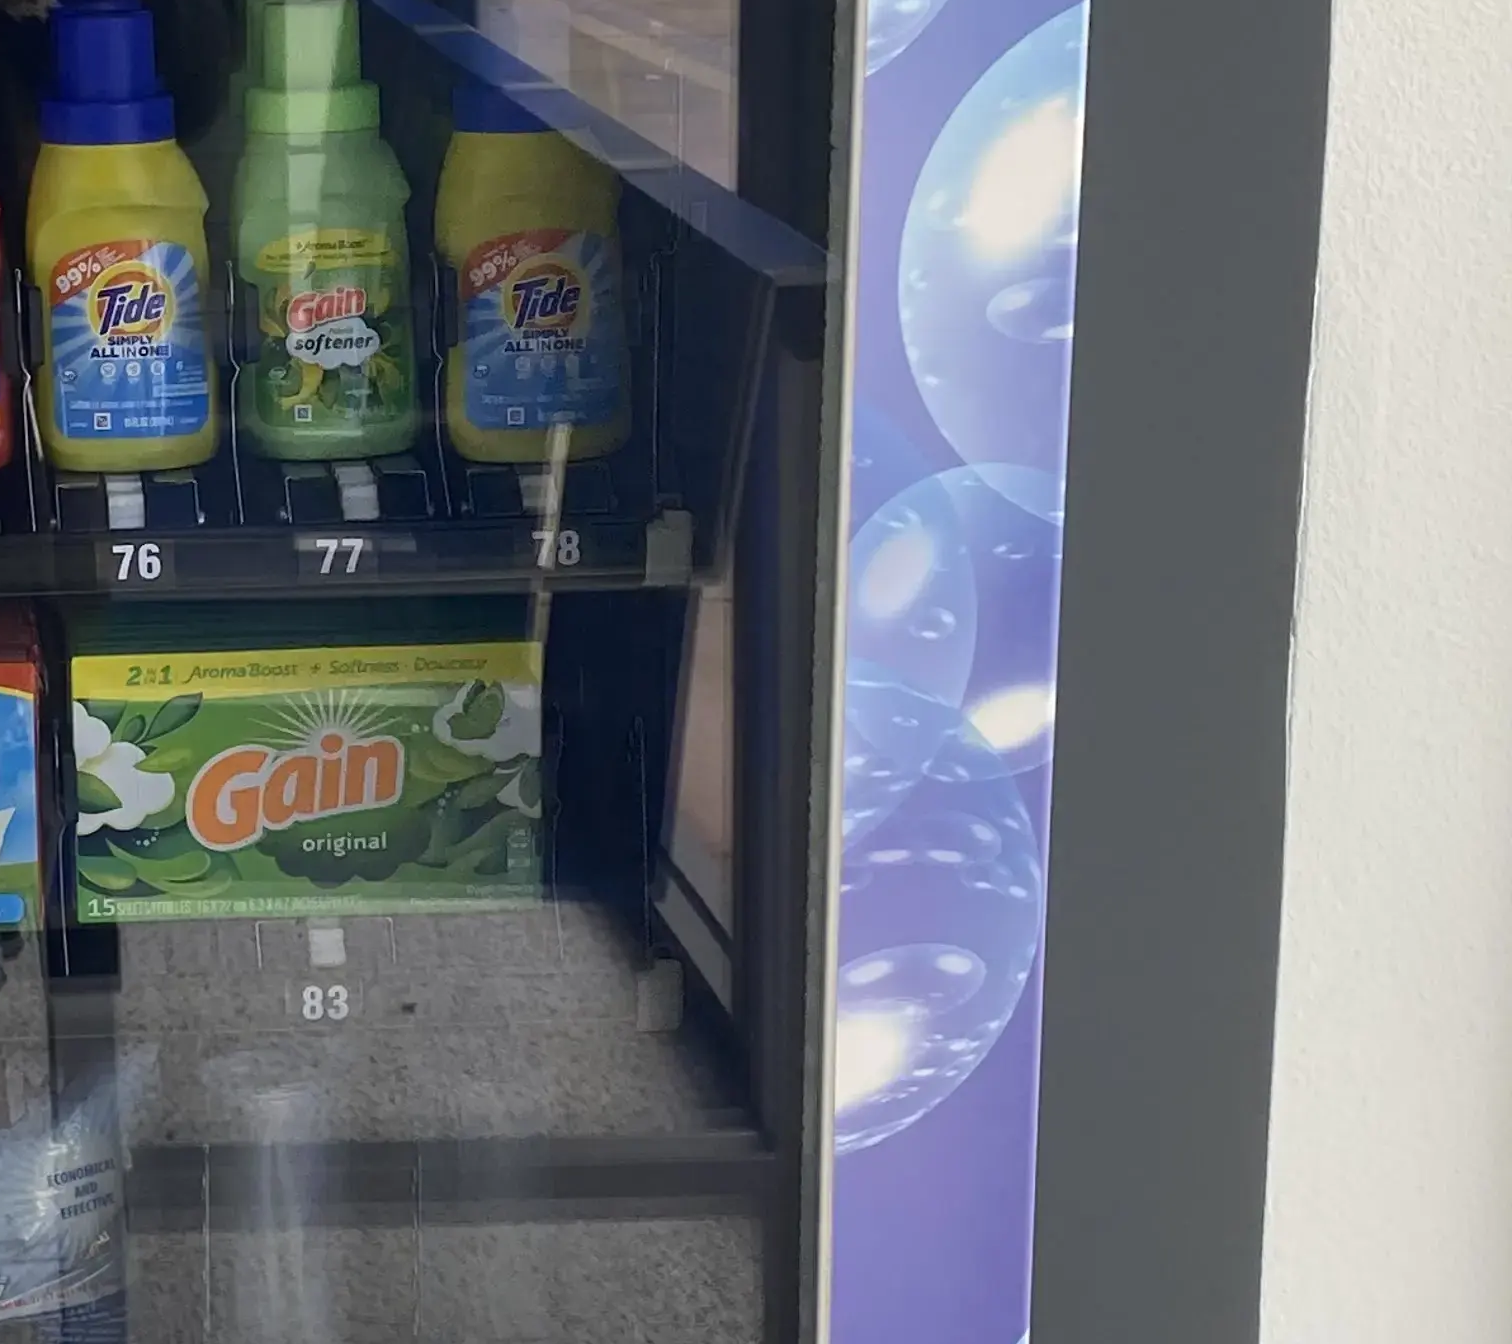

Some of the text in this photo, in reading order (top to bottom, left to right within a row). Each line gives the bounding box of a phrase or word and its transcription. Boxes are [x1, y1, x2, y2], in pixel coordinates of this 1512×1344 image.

[55, 255, 103, 294] 99%
[468, 249, 519, 288] 99%
[96, 281, 167, 337] Tide
[286, 286, 368, 333] Gain
[511, 276, 582, 330] Tide
[90, 347, 119, 359] ALL
[107, 335, 154, 346] SIMPLY
[294, 333, 374, 355] softener
[112, 543, 161, 582] 76
[315, 538, 364, 574] 77
[531, 530, 581, 568] 78
[185, 733, 406, 853] Gain
[301, 831, 388, 857] original
[88, 899, 116, 917] 15
[302, 985, 350, 1021] 83
[46, 1157, 117, 1187] ECONOMICAL
[74, 1182, 99, 1199] AND
